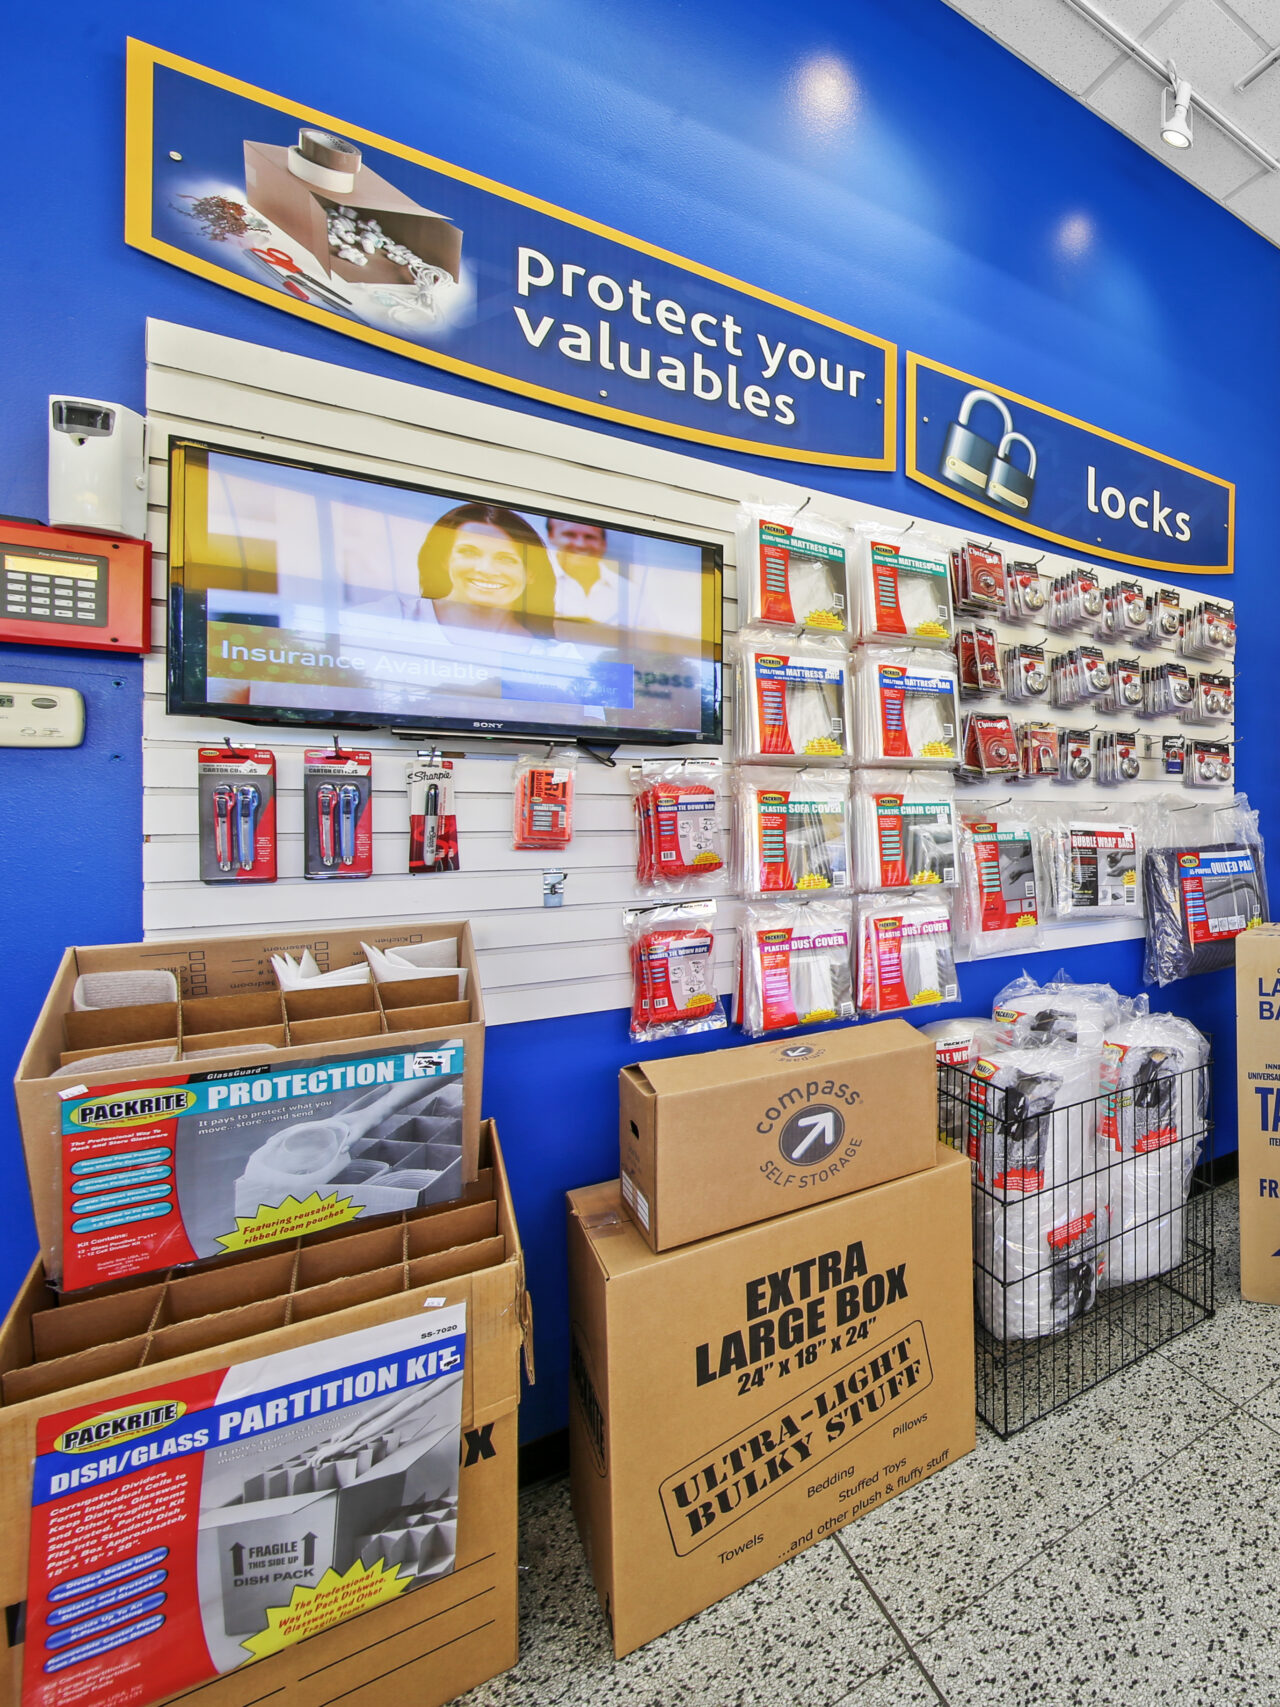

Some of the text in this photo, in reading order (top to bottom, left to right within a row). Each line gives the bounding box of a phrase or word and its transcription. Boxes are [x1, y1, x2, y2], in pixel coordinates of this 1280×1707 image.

[517, 246, 866, 398] protect your
[513, 306, 796, 425] valuables
[1087, 466, 1191, 542] locks
[791, 538, 843, 558] MATTRESS BAG
[221, 639, 366, 672] Insurance
[374, 654, 489, 682] Available
[413, 771, 451, 782] Sharpie
[535, 772, 544, 798] Handle
[788, 804, 810, 813] SOFA
[811, 804, 841, 813] COVER
[901, 805, 924, 814] CHAIR
[925, 805, 949, 814] COVER
[1072, 836, 1097, 848] BUBBLE
[1098, 836, 1117, 848] WRAP
[764, 936, 844, 952] PLASTIC DUST COVER
[879, 923, 948, 939] PLASTIC DUST COVER
[208, 1060, 394, 1110] PROTECTION
[79, 1092, 188, 1124] PACKRITE
[211, 1115, 235, 1126] pays
[251, 1106, 286, 1119] protect
[289, 1102, 313, 1111] what
[315, 1100, 332, 1109] you
[756, 1079, 862, 1135] compass
[760, 1136, 864, 1189] SELF STORAGE
[243, 1202, 336, 1235] Featuring reusable
[244, 1208, 344, 1244] ribbed foam pouches
[746, 1240, 868, 1322] EXTRA
[420, 1324, 458, 1340] SS-7020
[696, 1263, 909, 1388] LARGE BOX
[50, 1346, 460, 1495] DISH/GLASS PARTITION KIT
[62, 1402, 178, 1451] PACKRITE
[672, 1338, 912, 1509] ULTRA-LIGHT
[892, 1412, 929, 1438] Pillows
[685, 1360, 921, 1536] BULKY STUFF
[50, 1472, 167, 1516] Corrugated Dividers
[807, 1464, 855, 1498] Bedding
[838, 1457, 907, 1503] Stuffed Toys
[777, 1450, 950, 1559] ...and other plush & fluffy stuff
[249, 1541, 298, 1559] FRAGILE
[717, 1532, 765, 1564] Towels
[234, 1568, 314, 1587] DISH PACK
